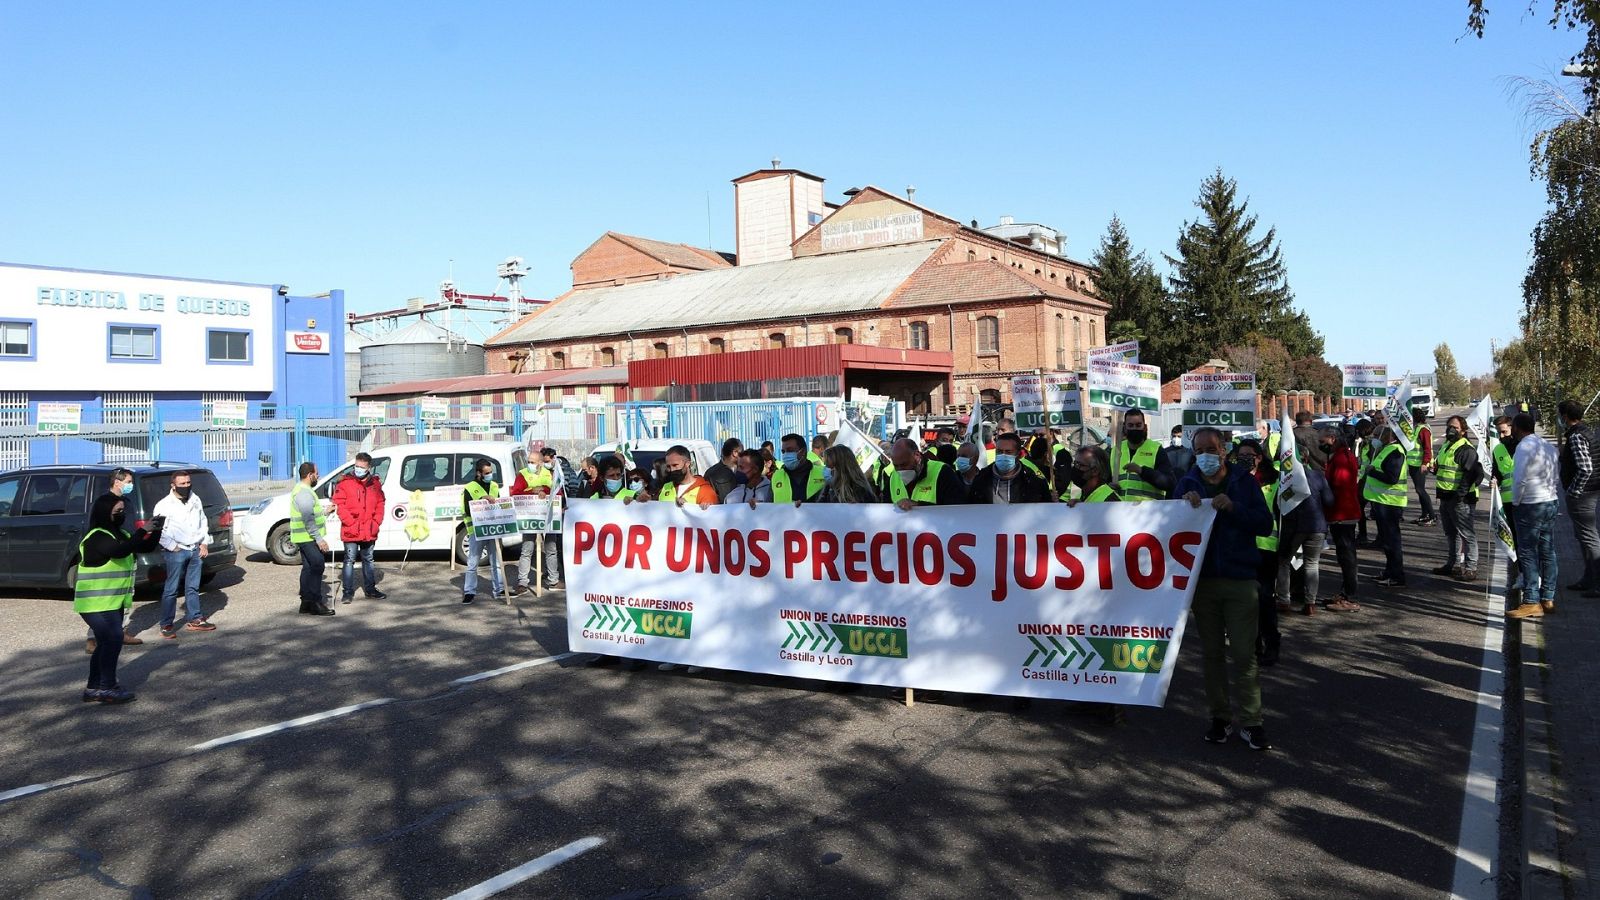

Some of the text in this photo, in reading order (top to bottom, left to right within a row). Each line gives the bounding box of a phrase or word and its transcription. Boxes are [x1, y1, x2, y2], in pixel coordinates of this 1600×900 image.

[37, 286, 250, 316] FABRICA DE QUESOS
[1213, 374, 1253, 382] CAMPESINOS
[1350, 387, 1379, 396] UCCL
[1101, 391, 1146, 409] UCCL
[217, 418, 239, 427] UCCL
[1027, 412, 1069, 426] UCCL
[1195, 412, 1241, 425] UCCL
[44, 423, 72, 431] UCCL
[441, 508, 461, 516] UCC
[481, 524, 510, 536] UCCL
[521, 520, 546, 530] UCC
[573, 521, 1202, 602] POR UNOS PRECIOS JUSTOS
[584, 592, 694, 611] UNION DE CAMPESINOS
[641, 612, 685, 637] UCCL
[780, 609, 907, 628] UNION DE CAMPESINOS
[582, 629, 645, 645] Castilla y León
[1018, 623, 1174, 639] UNION DE CAMPESINO
[848, 629, 902, 656] UCCL
[779, 650, 853, 666] Castilla y León
[1112, 642, 1164, 671] UCC
[1022, 668, 1117, 685] Castilla y León
